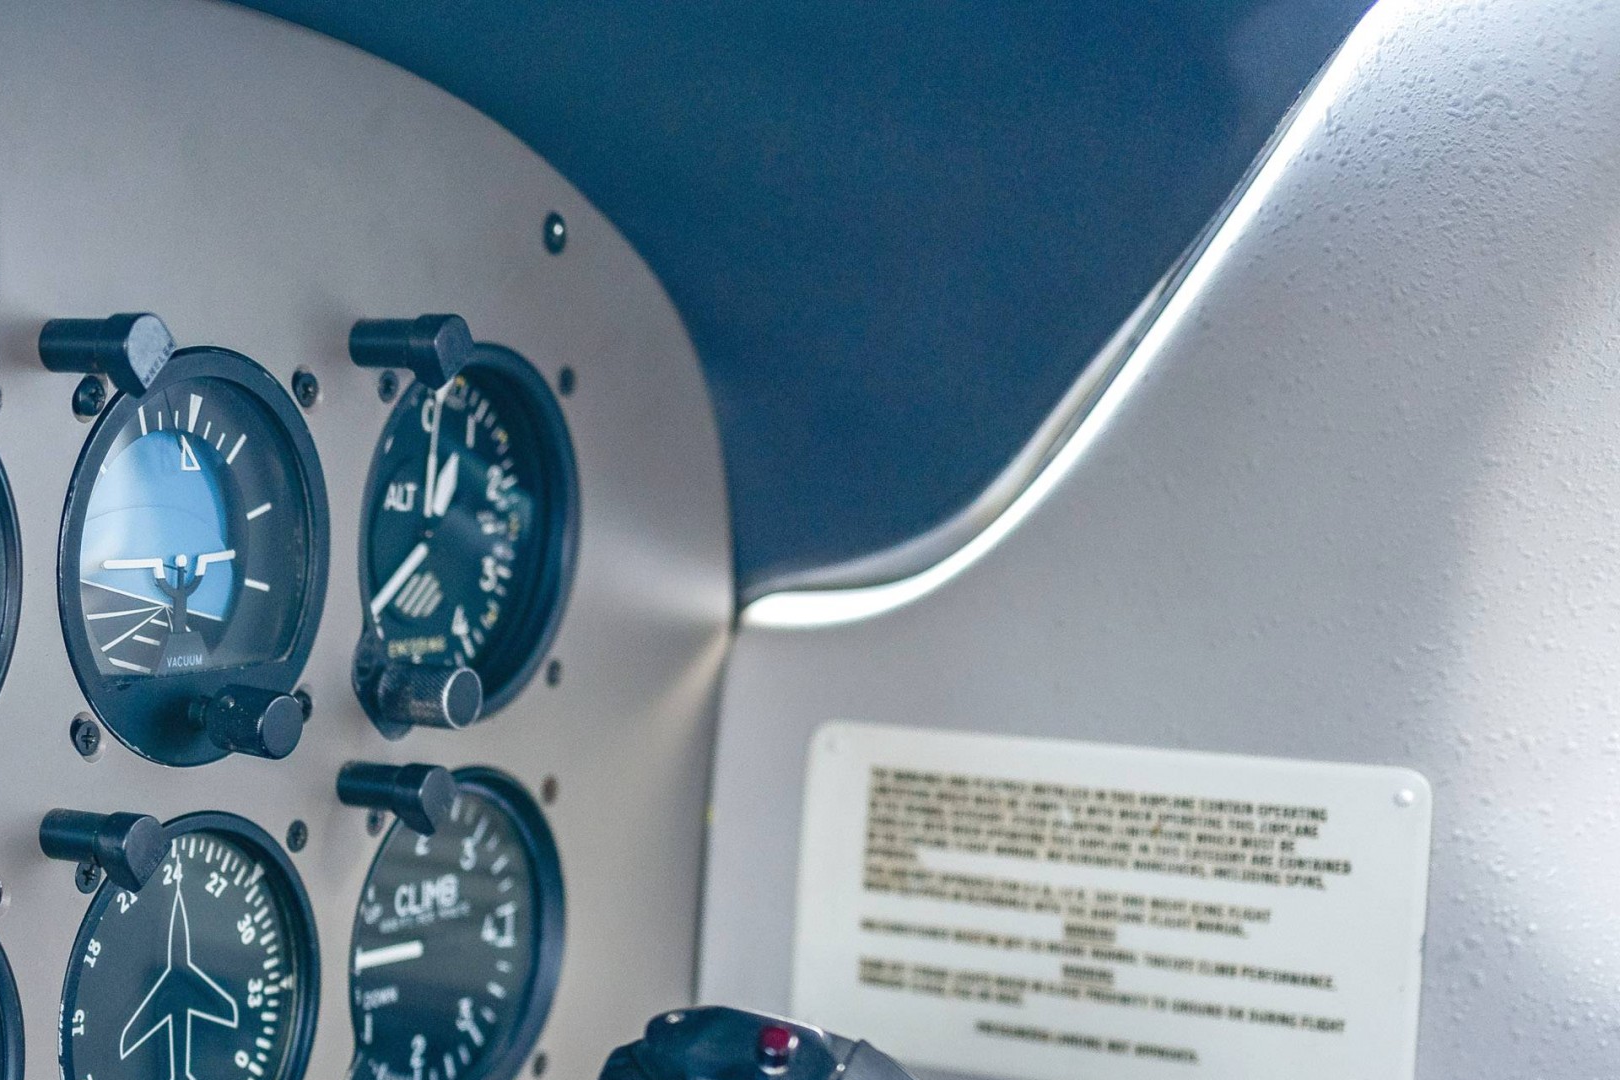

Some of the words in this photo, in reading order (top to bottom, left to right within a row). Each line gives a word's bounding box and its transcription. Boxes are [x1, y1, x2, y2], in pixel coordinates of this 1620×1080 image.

[384, 480, 418, 513] ALT
[166, 654, 203, 668] VACUUM
[163, 862, 183, 885] 24
[205, 872, 229, 898] 27
[394, 873, 459, 918] CLIMB
[237, 913, 255, 945] 30
[83, 938, 101, 968] 18
[247, 978, 263, 1008] 33
[72, 1009, 85, 1037] 15
[234, 1050, 250, 1068] 0
